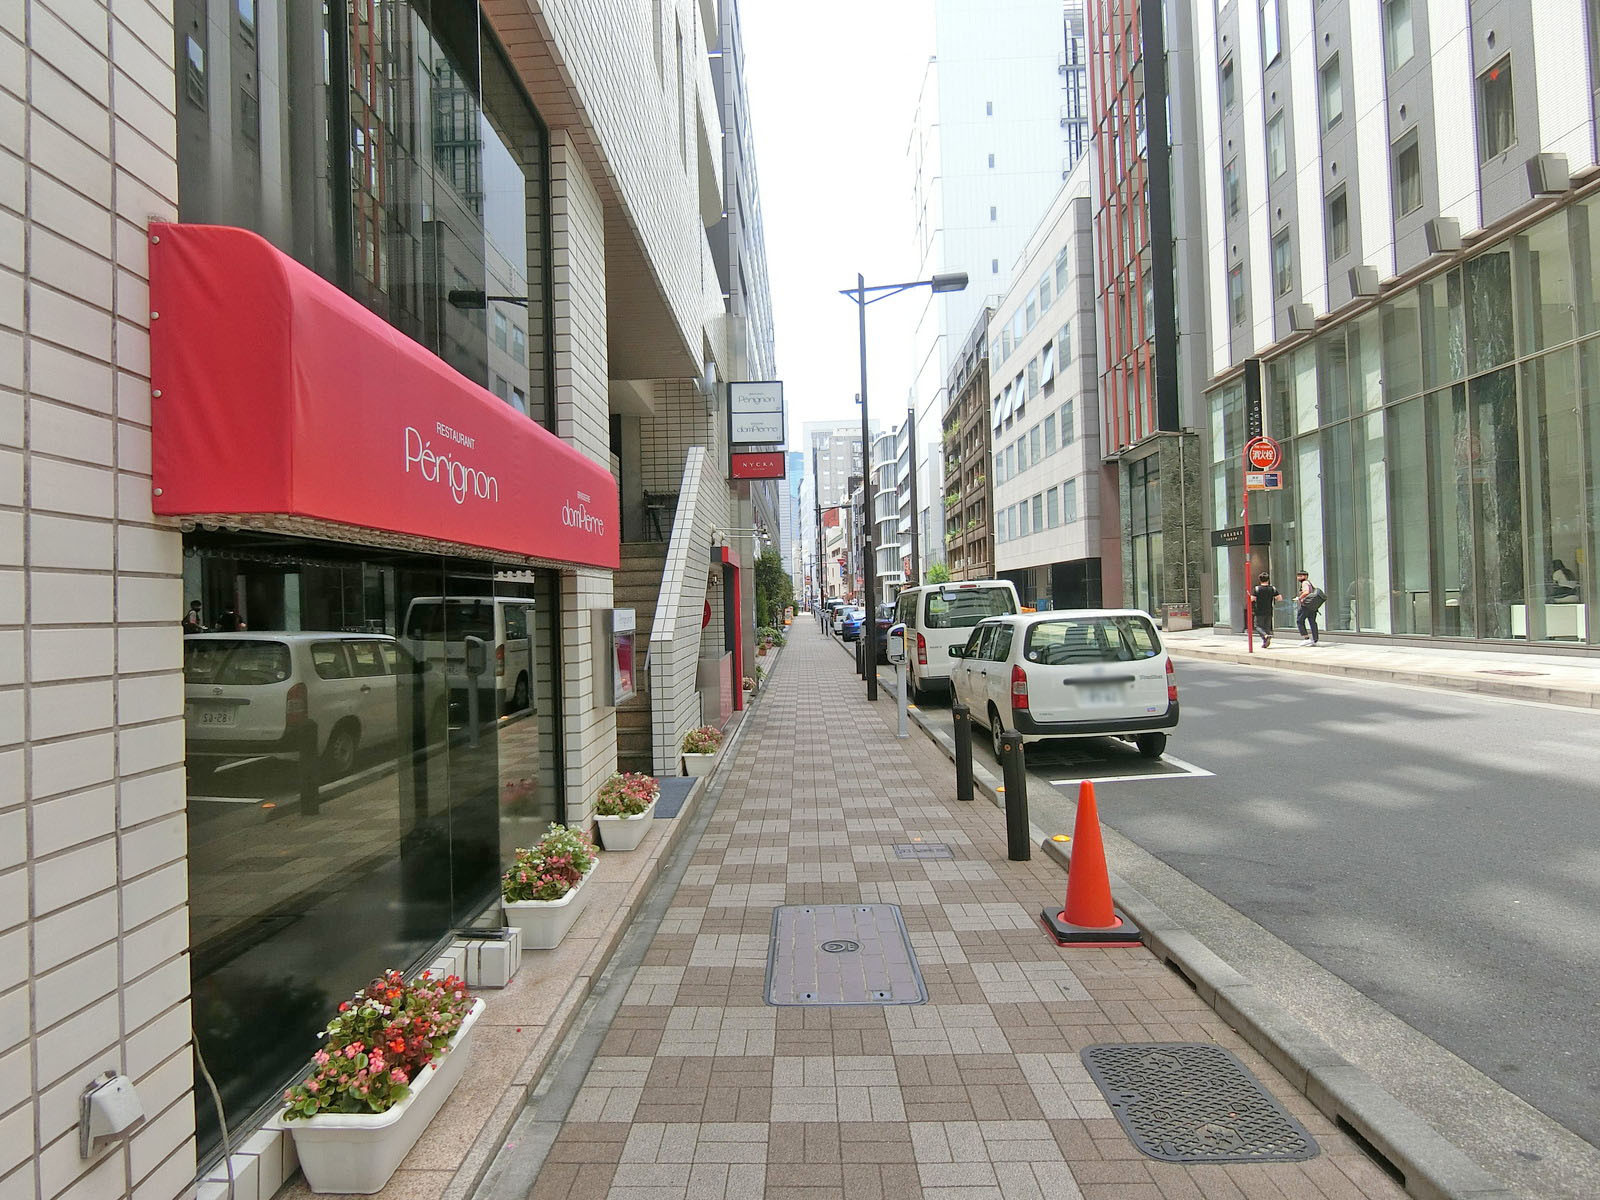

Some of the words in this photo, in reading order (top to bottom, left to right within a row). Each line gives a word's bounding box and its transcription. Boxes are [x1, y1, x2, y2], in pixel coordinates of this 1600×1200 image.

[435, 421, 475, 449] RESTAURANT
[404, 426, 498, 504] Pérignon
[1252, 450, 1274, 460] 消火栓
[561, 499, 604, 536] domPierre
